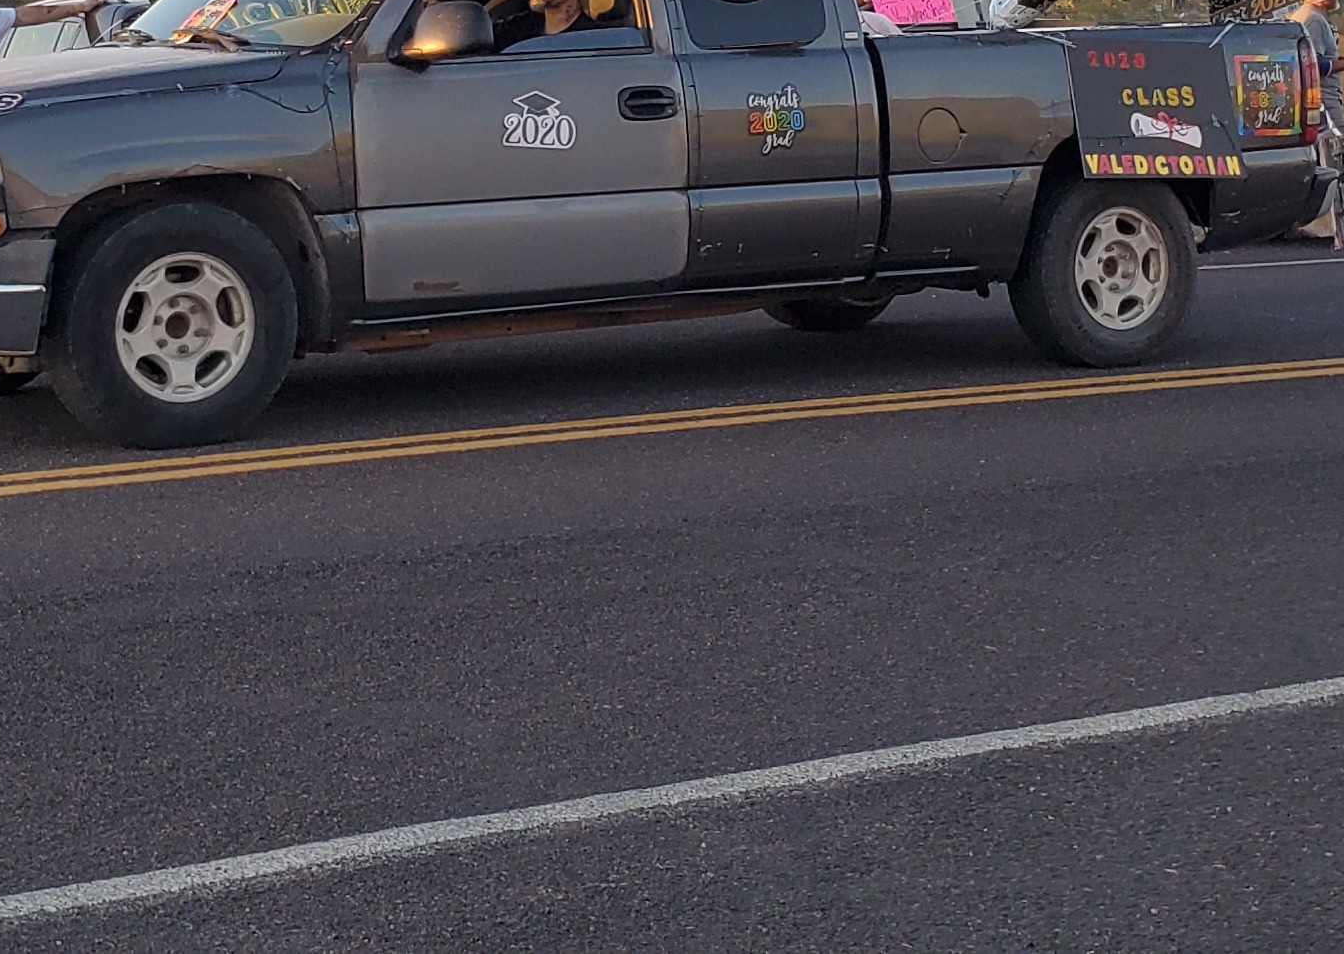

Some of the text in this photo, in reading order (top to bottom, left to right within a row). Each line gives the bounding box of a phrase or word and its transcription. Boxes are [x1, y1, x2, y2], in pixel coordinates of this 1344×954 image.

[749, 86, 800, 118] congrats
[1121, 85, 1195, 107] CLASS
[749, 109, 804, 133] 2020
[1255, 107, 1283, 129] grad
[504, 114, 575, 147] 2020
[762, 129, 795, 154] grad
[1084, 153, 1242, 176] VALEDICTORIAN
